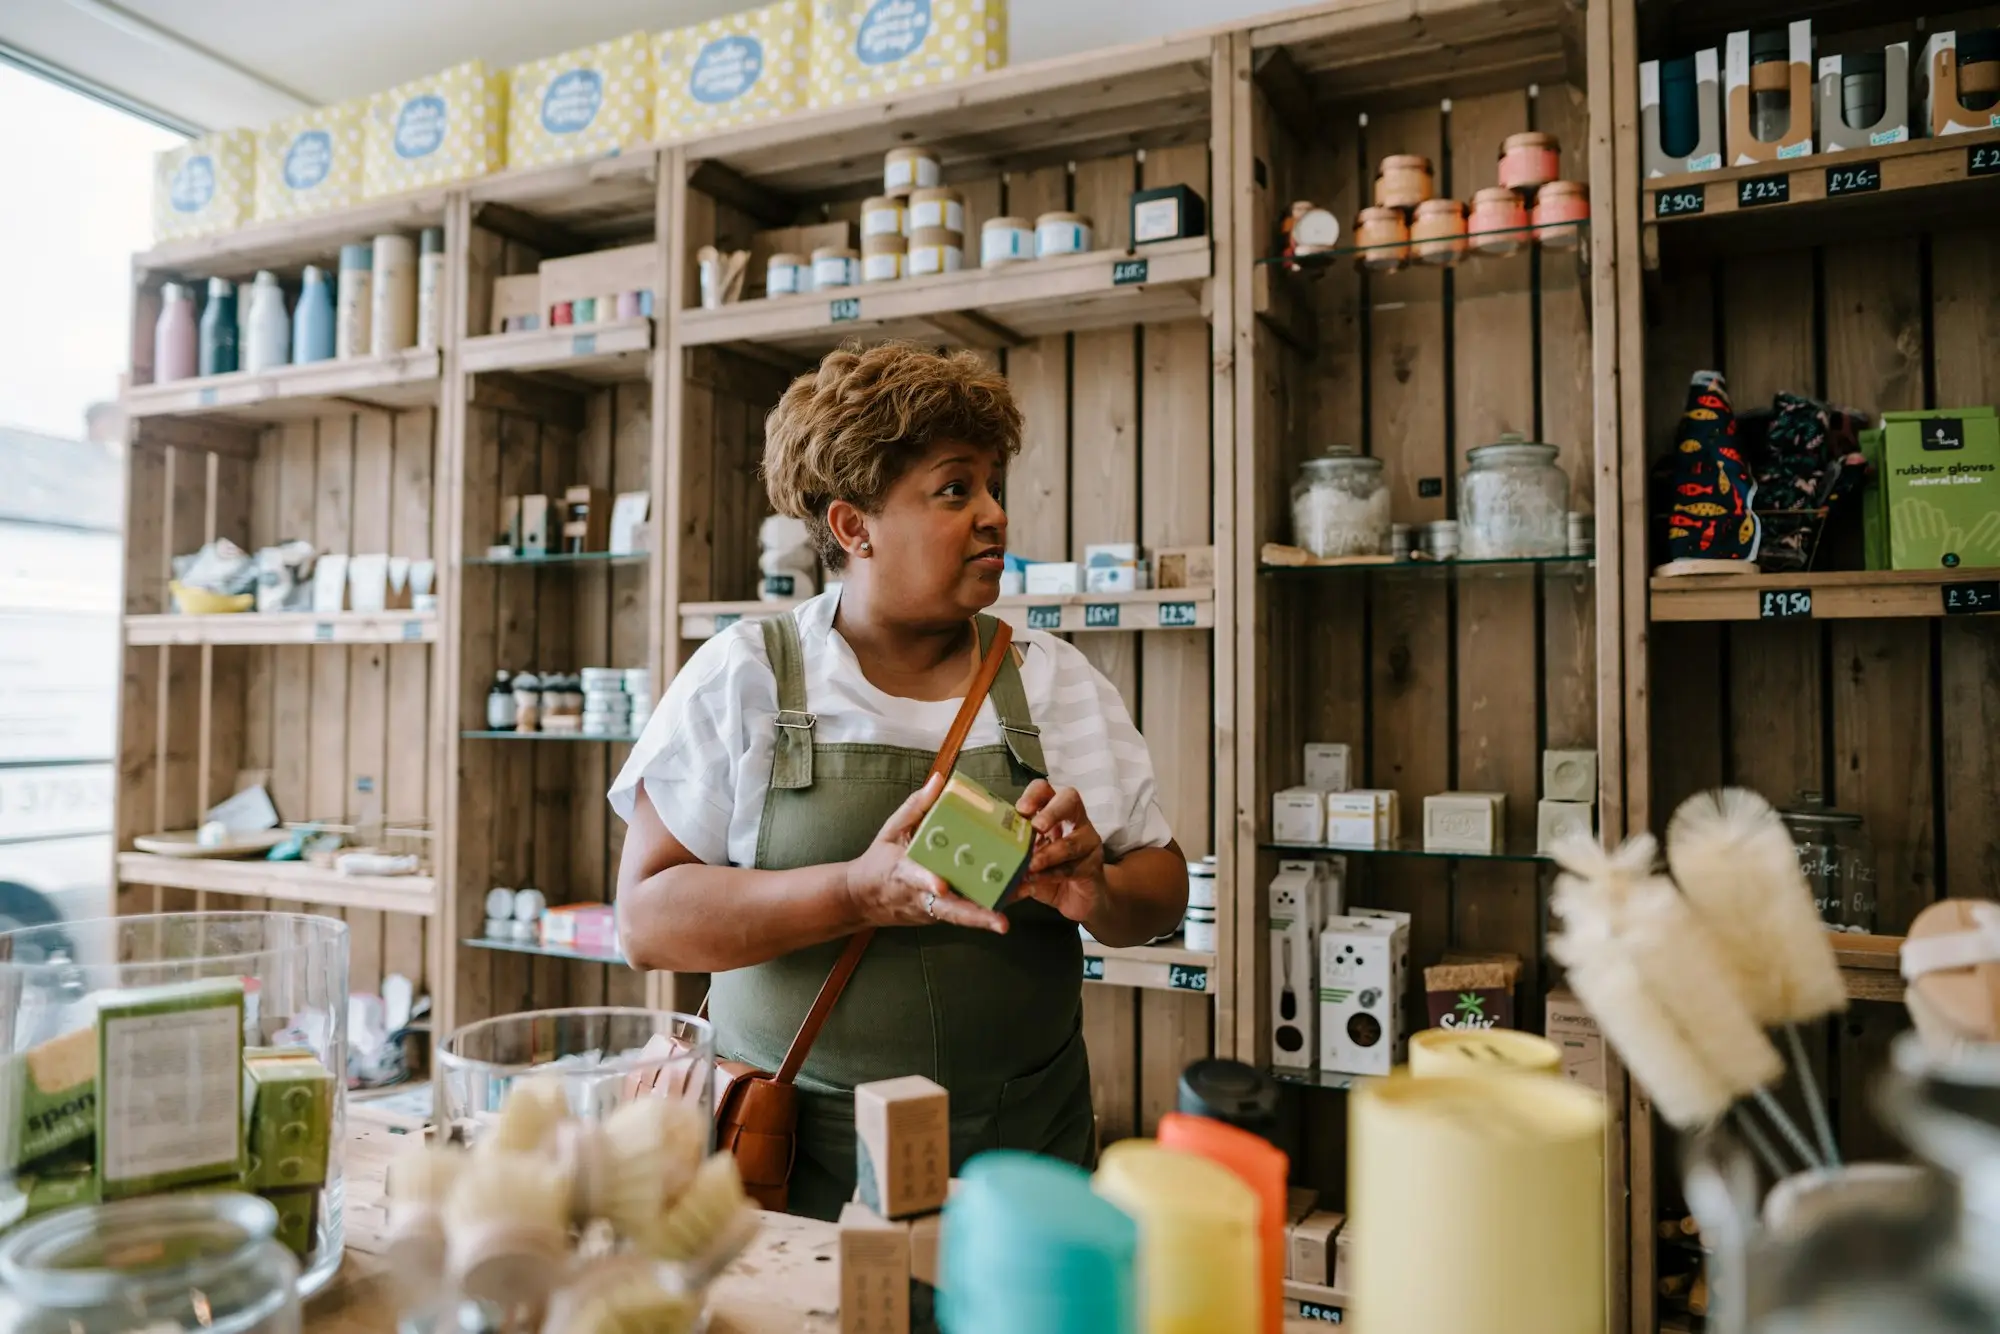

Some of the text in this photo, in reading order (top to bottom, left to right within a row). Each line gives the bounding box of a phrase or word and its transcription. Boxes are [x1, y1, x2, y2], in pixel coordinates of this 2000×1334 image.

[1896, 461, 1996, 476] rubber gloves
[1908, 473, 1982, 486] natural latex
[1762, 592, 1811, 617] £9.50
